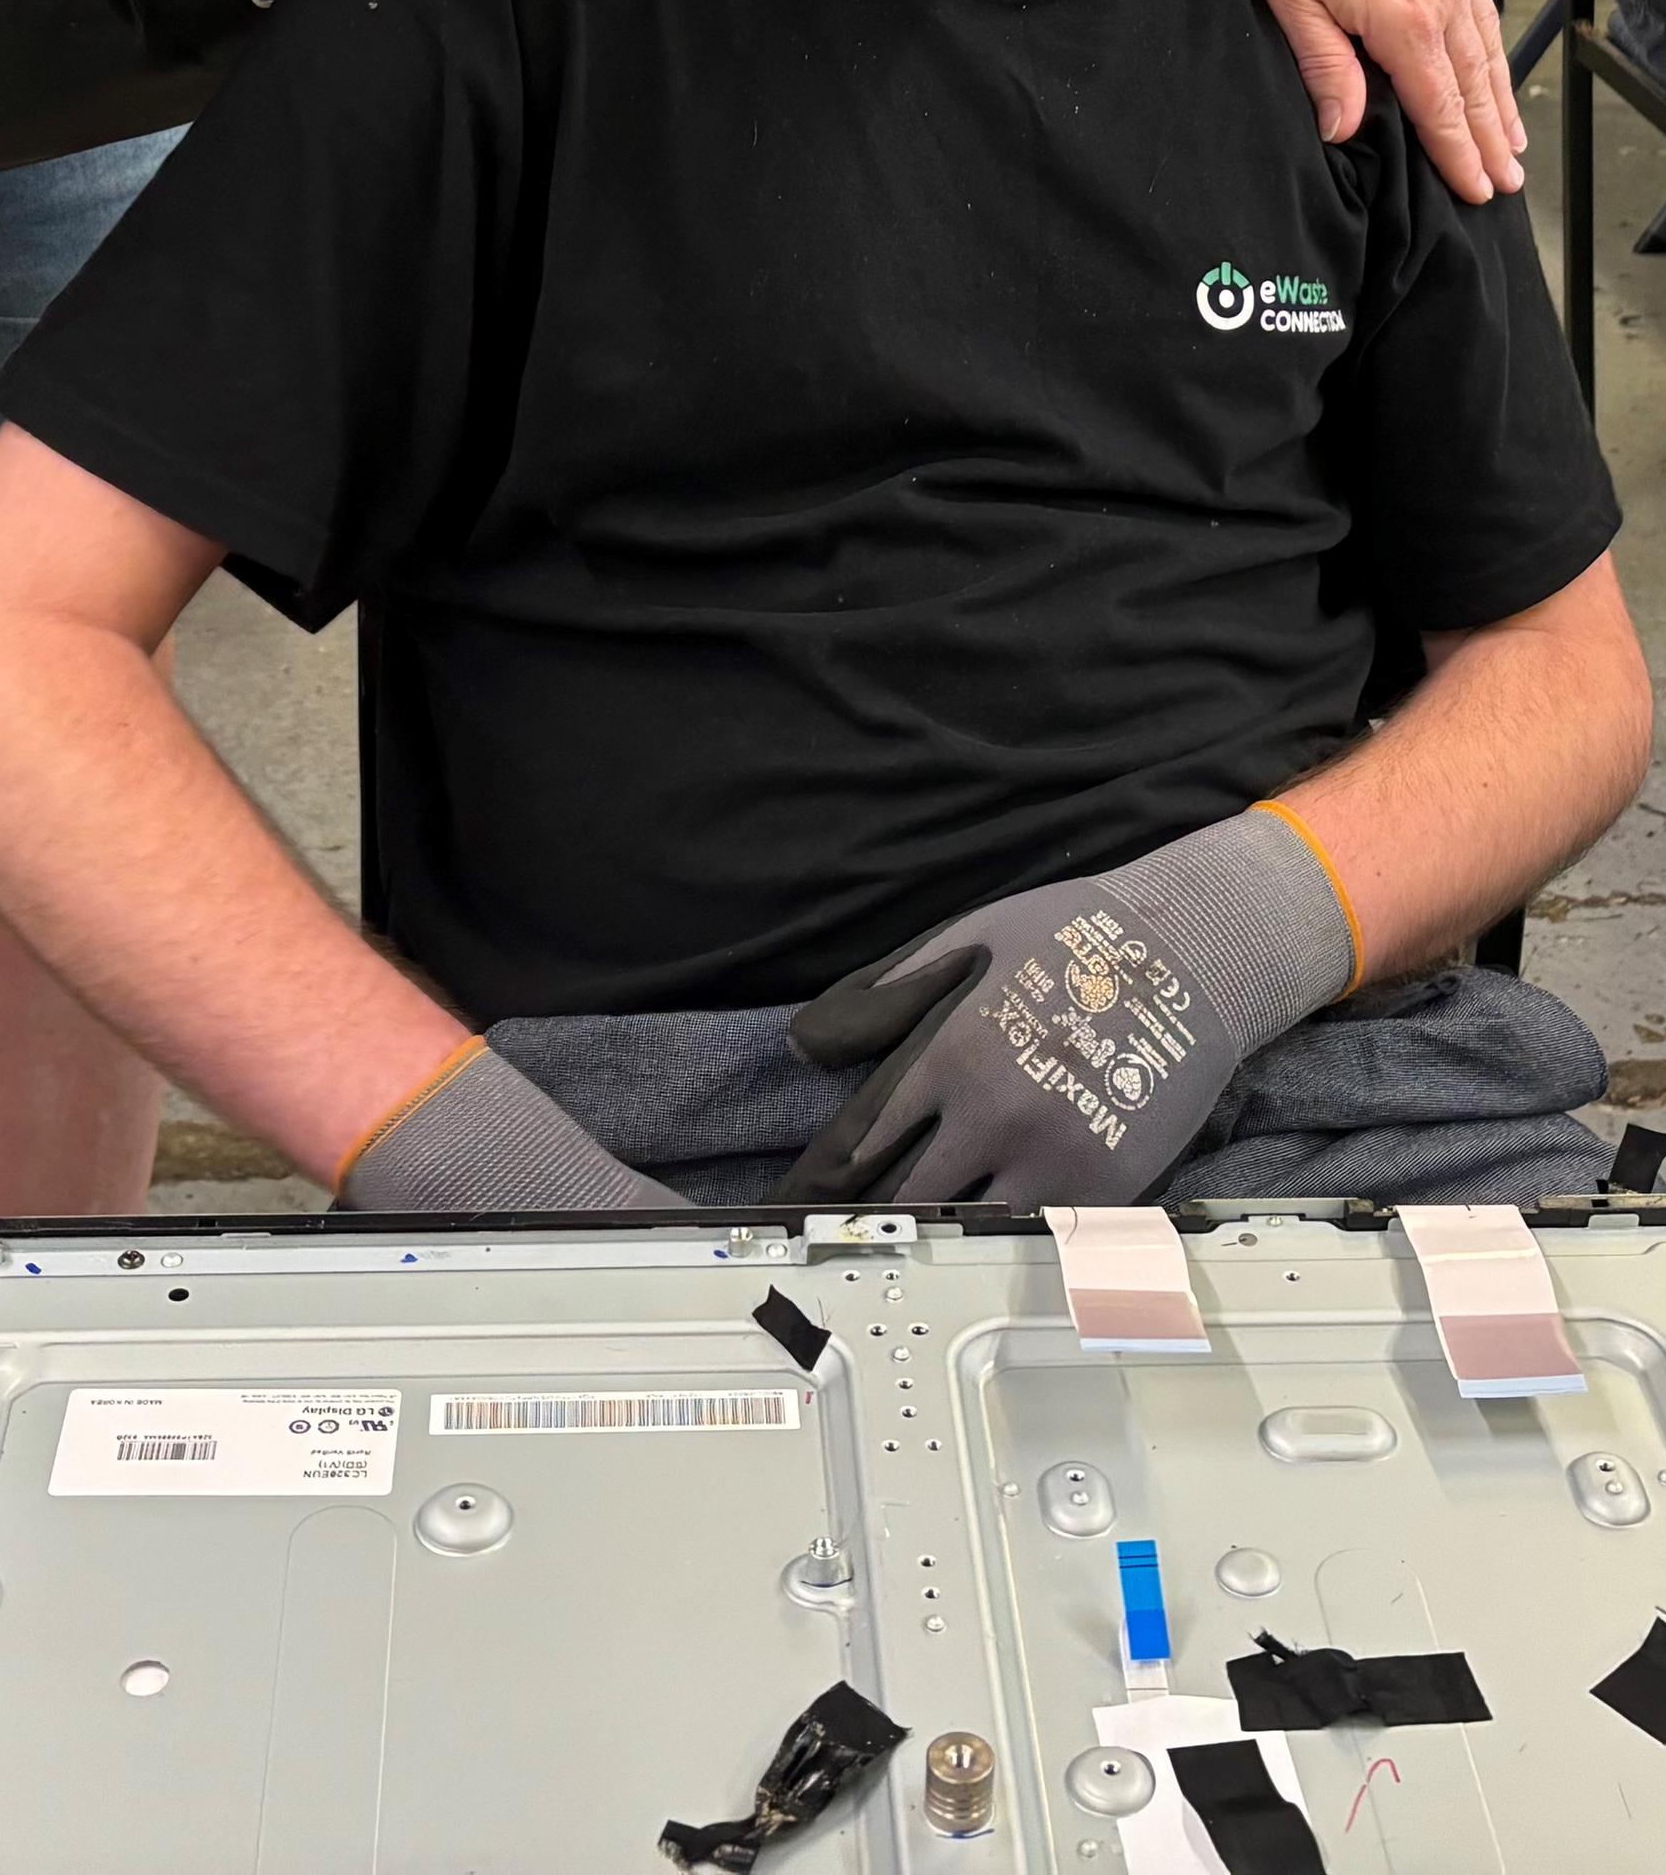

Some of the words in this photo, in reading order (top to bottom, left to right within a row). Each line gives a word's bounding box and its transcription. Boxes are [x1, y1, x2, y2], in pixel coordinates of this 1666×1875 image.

[1259, 274, 1328, 305] eWaste
[302, 1406, 351, 1416] Display
[354, 1407, 375, 1416] LG
